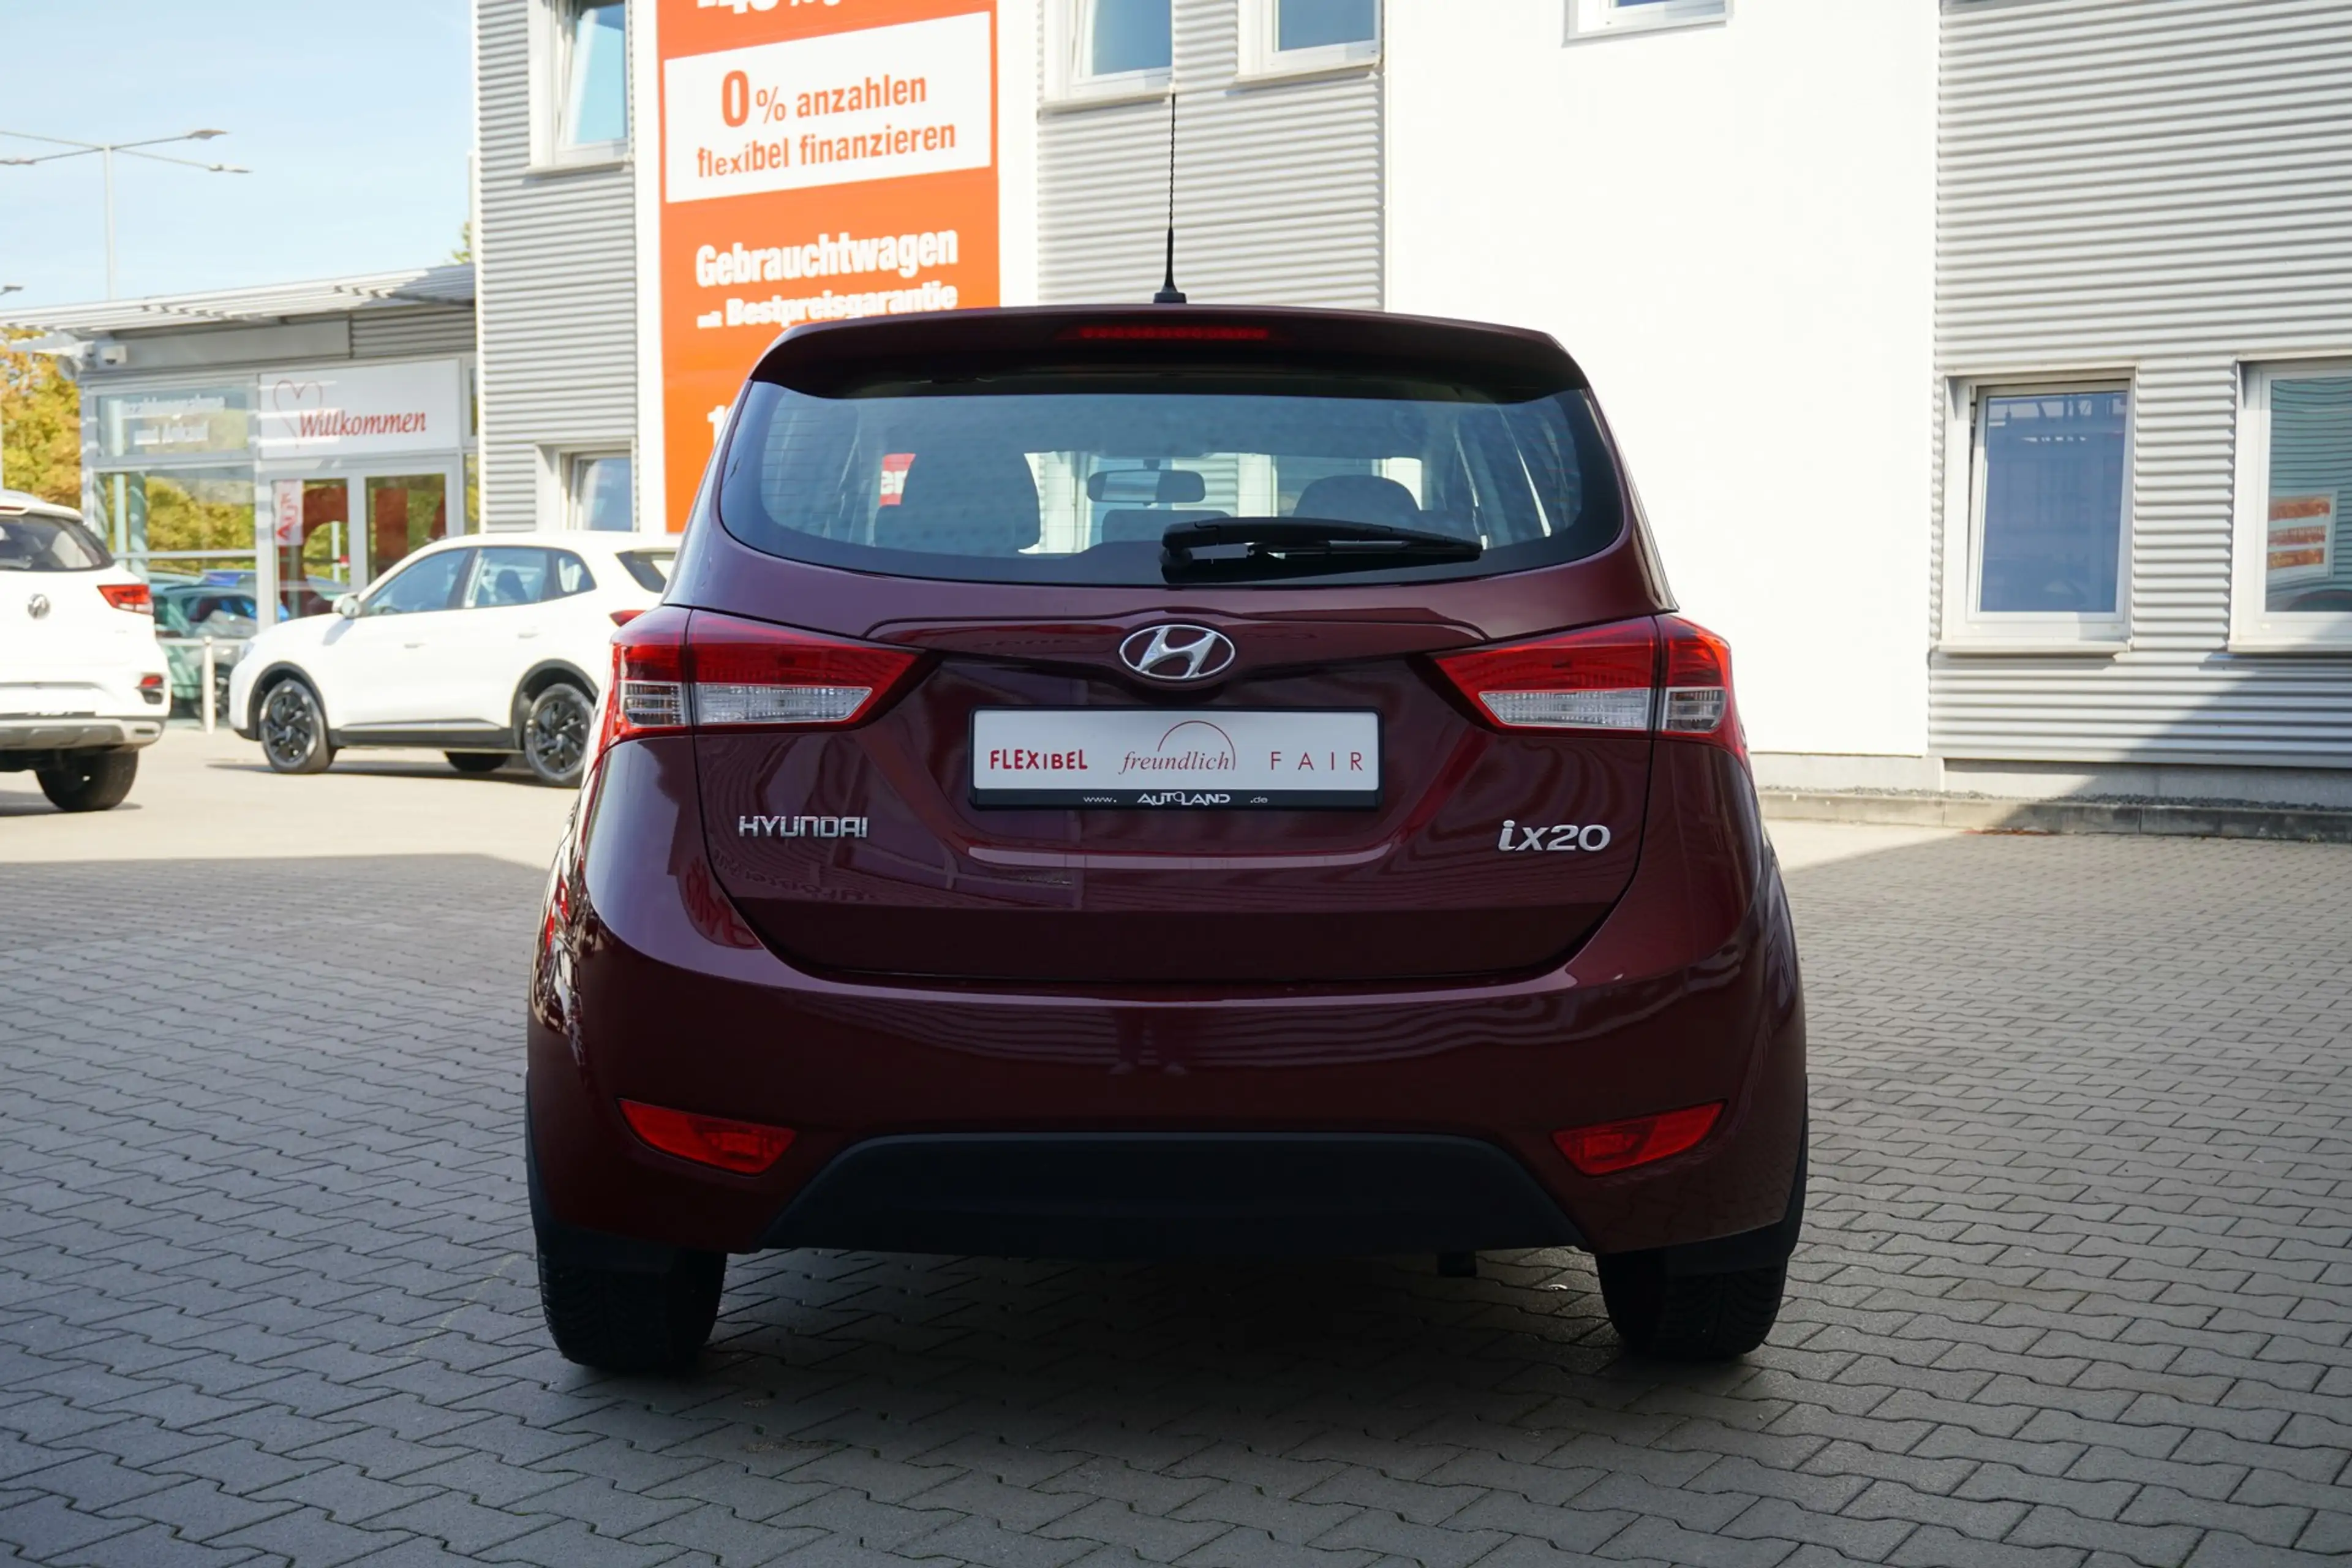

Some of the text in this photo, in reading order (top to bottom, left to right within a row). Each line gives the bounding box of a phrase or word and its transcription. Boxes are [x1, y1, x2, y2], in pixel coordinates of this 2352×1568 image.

[796, 74, 927, 118] anzahlen
[697, 124, 956, 178] flexibel finanzieren
[696, 229, 959, 287] Gebrauchtwagen
[726, 280, 958, 327] Bestpreisgarantie
[300, 409, 426, 437] Willkommen
[990, 749, 1088, 770] FLEXIBEL
[1118, 750, 1230, 775] freundlich
[1270, 752, 1363, 771] FAIR
[1137, 791, 1231, 805] AUTOLAND
[739, 816, 869, 838] HYUNDAI
[1498, 820, 1611, 851] ix20
